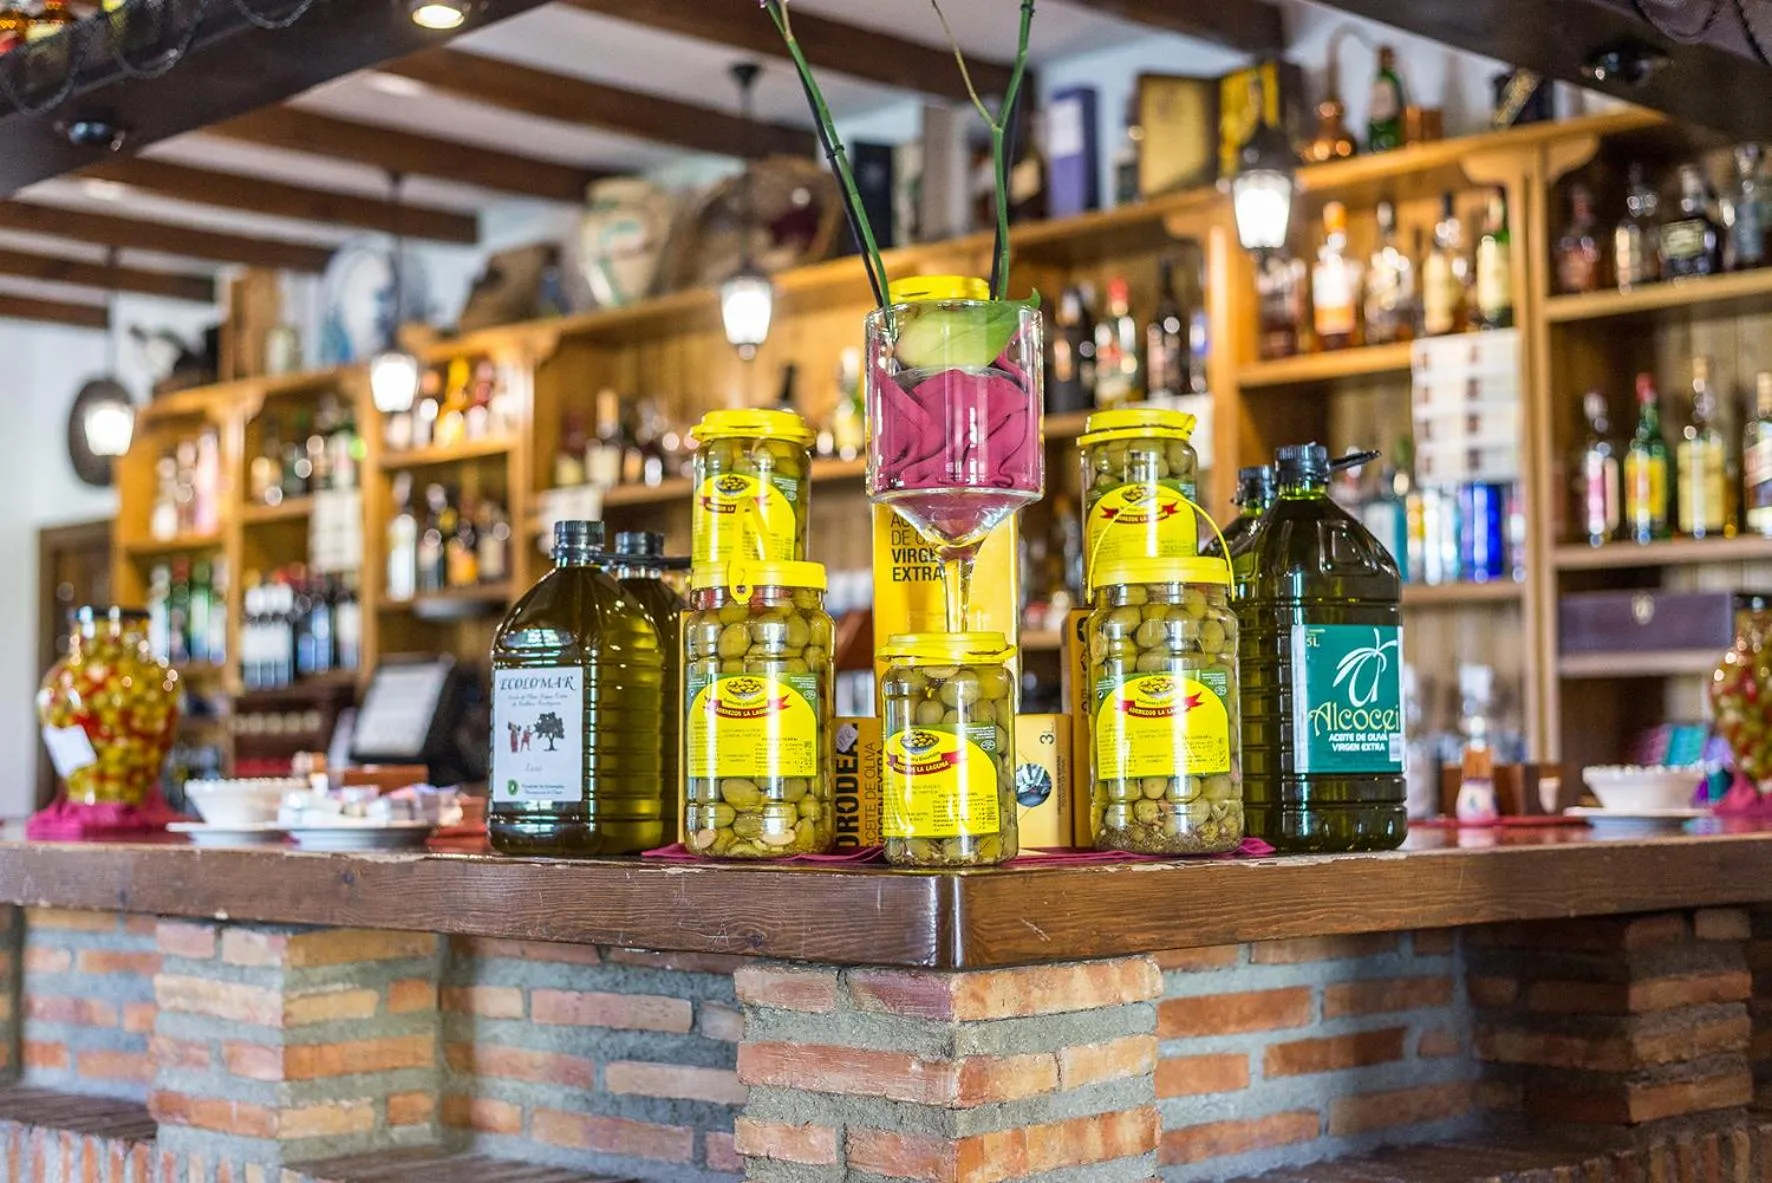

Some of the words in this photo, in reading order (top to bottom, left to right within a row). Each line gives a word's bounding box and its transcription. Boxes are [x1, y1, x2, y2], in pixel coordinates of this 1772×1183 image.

[891, 530, 910, 546] DE
[892, 566, 943, 582] EXTRA
[1306, 636, 1320, 648] 5L
[1328, 733, 1354, 742] ACEITE
[1356, 733, 1366, 742] DE
[1367, 733, 1388, 742] OLIVA
[1332, 743, 1360, 752] VIRGEN
[1361, 743, 1386, 752] EXTRA
[864, 742, 877, 780] OLIVA
[864, 782, 877, 799] DE
